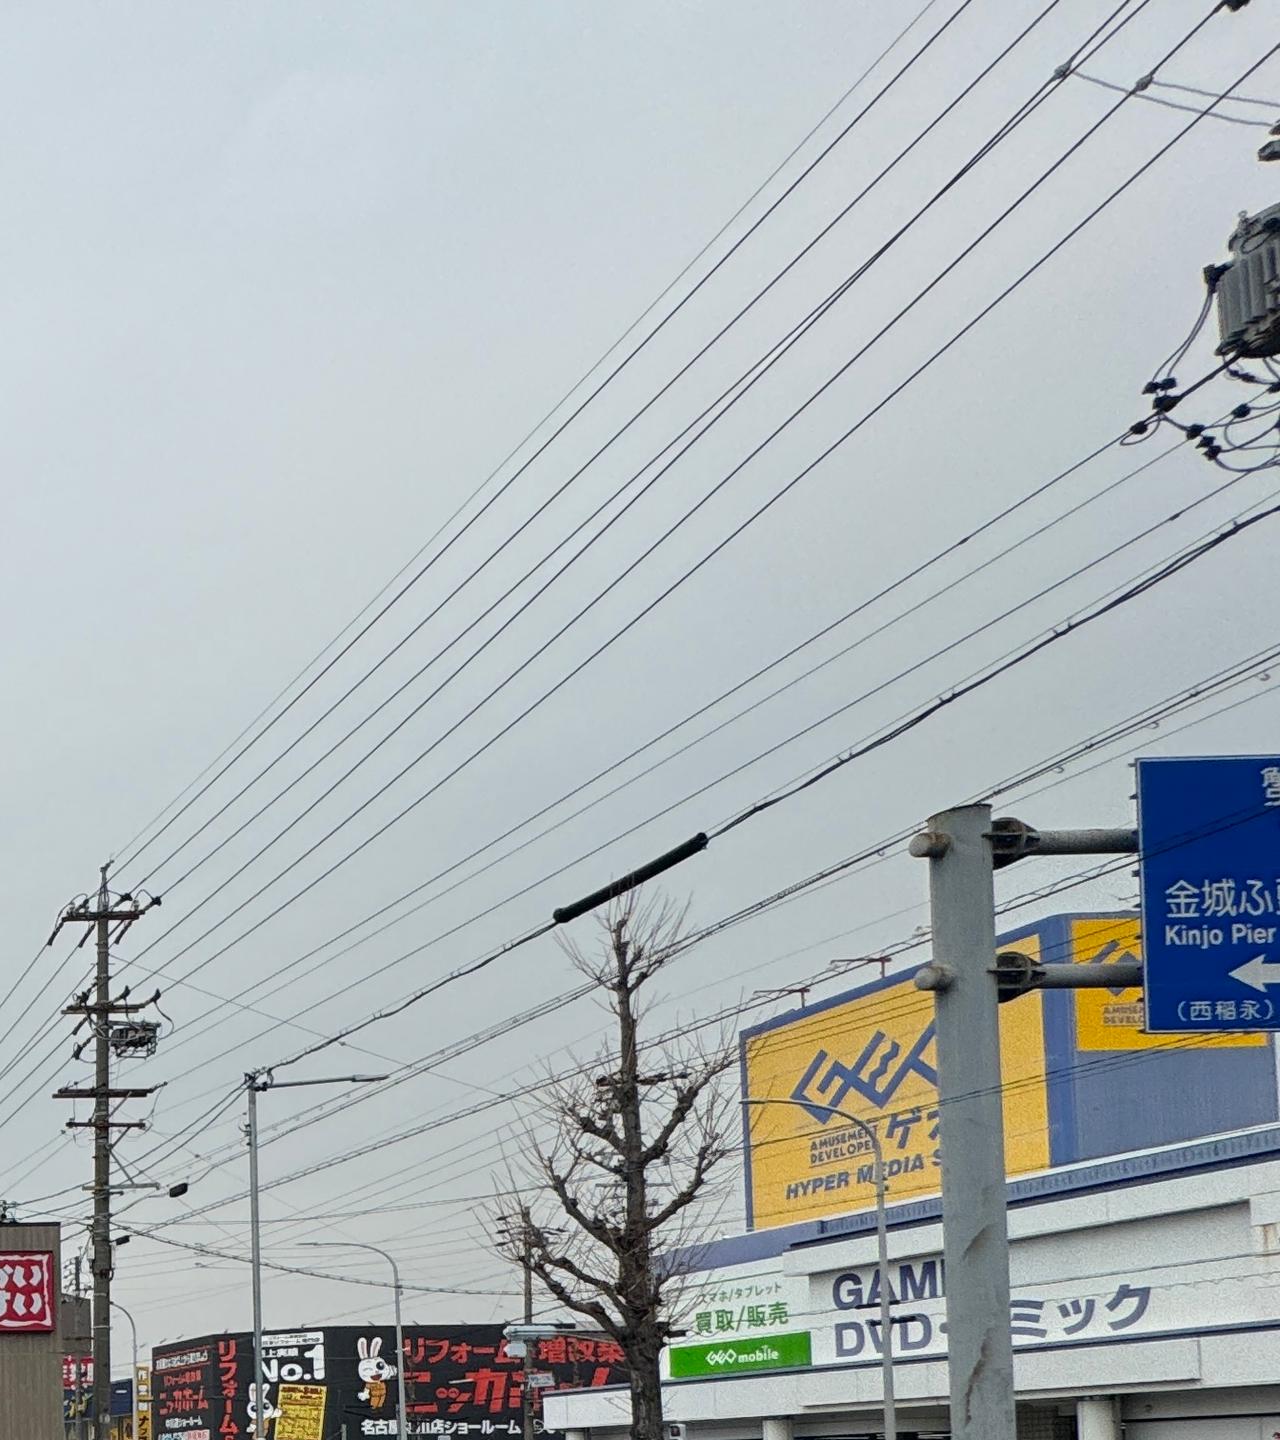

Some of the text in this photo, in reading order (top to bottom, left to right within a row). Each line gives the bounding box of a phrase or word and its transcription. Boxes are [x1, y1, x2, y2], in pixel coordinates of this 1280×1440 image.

[1165, 879, 1280, 918] 金城ふ
[1164, 923, 1276, 950] Kinjo Pier
[810, 1139, 878, 1164] DEVELOPE
[786, 1171, 850, 1200] HYPER
[832, 1259, 944, 1311] GAM
[695, 1301, 789, 1334] 買取/販売
[737, 1344, 780, 1363] mobile
[361, 1419, 523, 1436] 名古屋川店ショールーム
